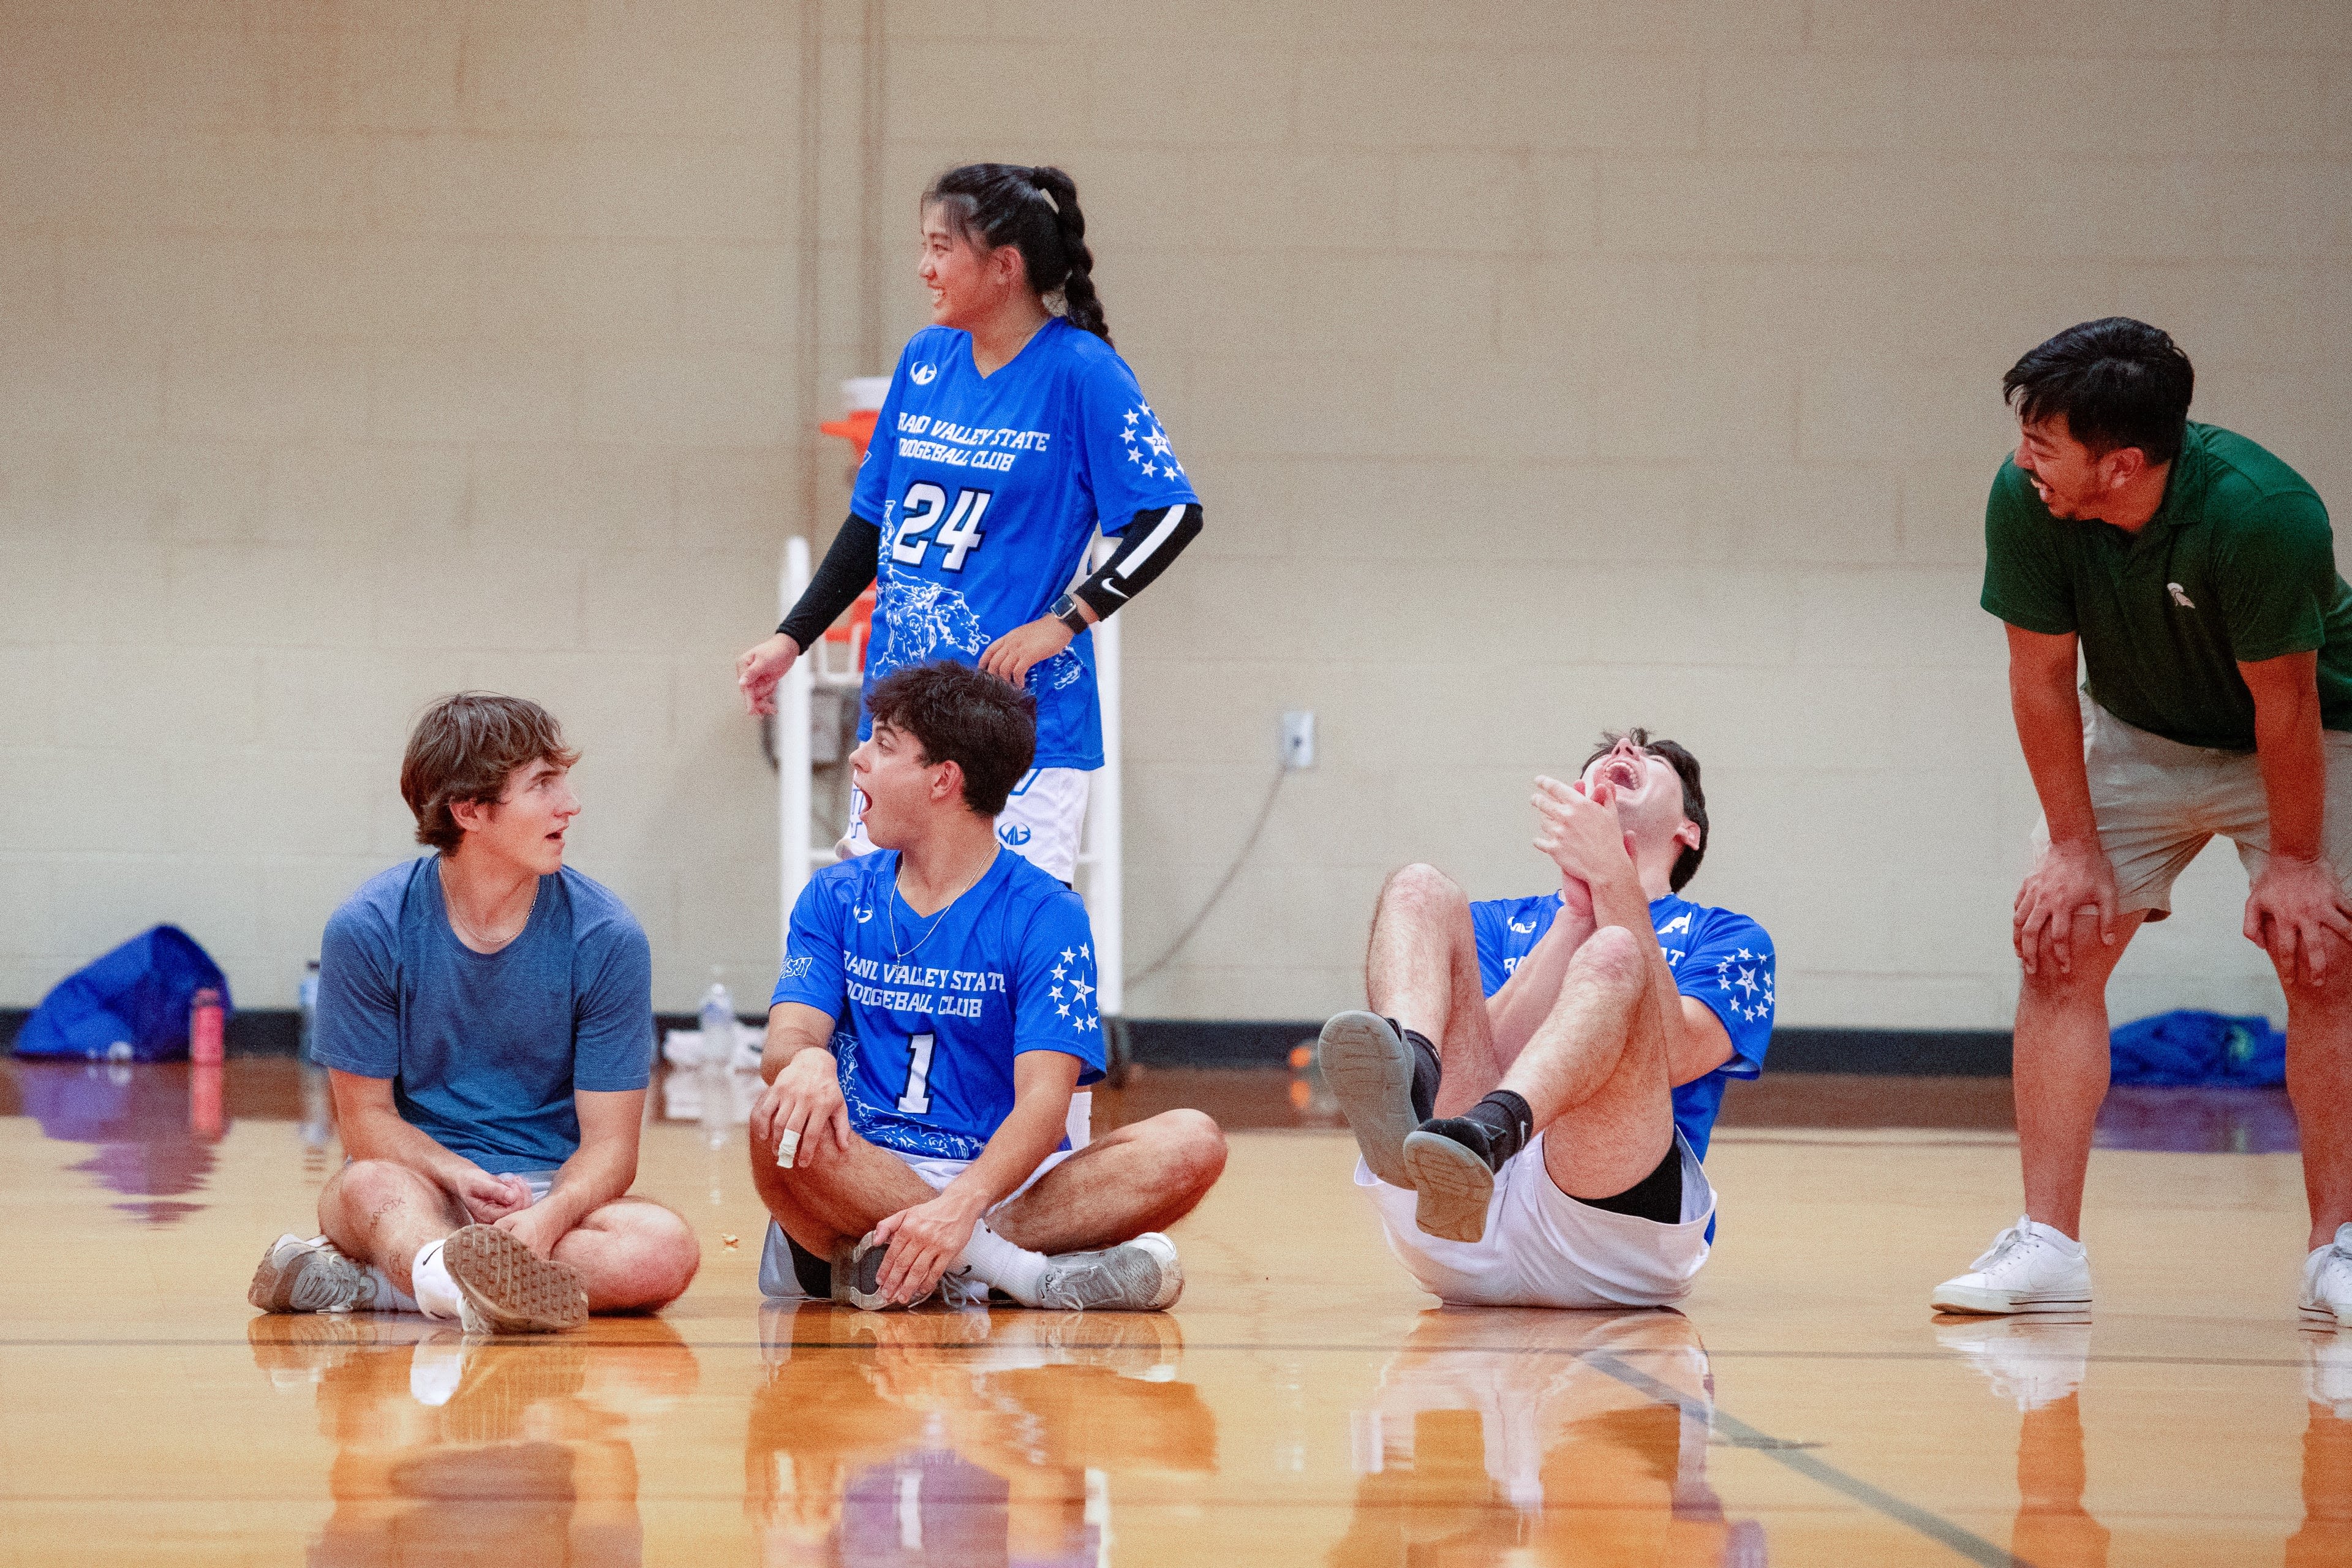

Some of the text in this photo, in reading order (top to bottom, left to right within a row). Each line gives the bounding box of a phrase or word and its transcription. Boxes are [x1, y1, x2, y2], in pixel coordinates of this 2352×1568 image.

[930, 420, 995, 446] VALLEY
[990, 428, 1050, 451] STATE
[1153, 438, 1165, 447] 22
[970, 450, 1016, 472] CLUB
[888, 480, 995, 574] 24
[884, 963, 950, 989] VALLEY
[938, 996, 983, 1017] CLUB
[895, 1030, 937, 1114] 1
